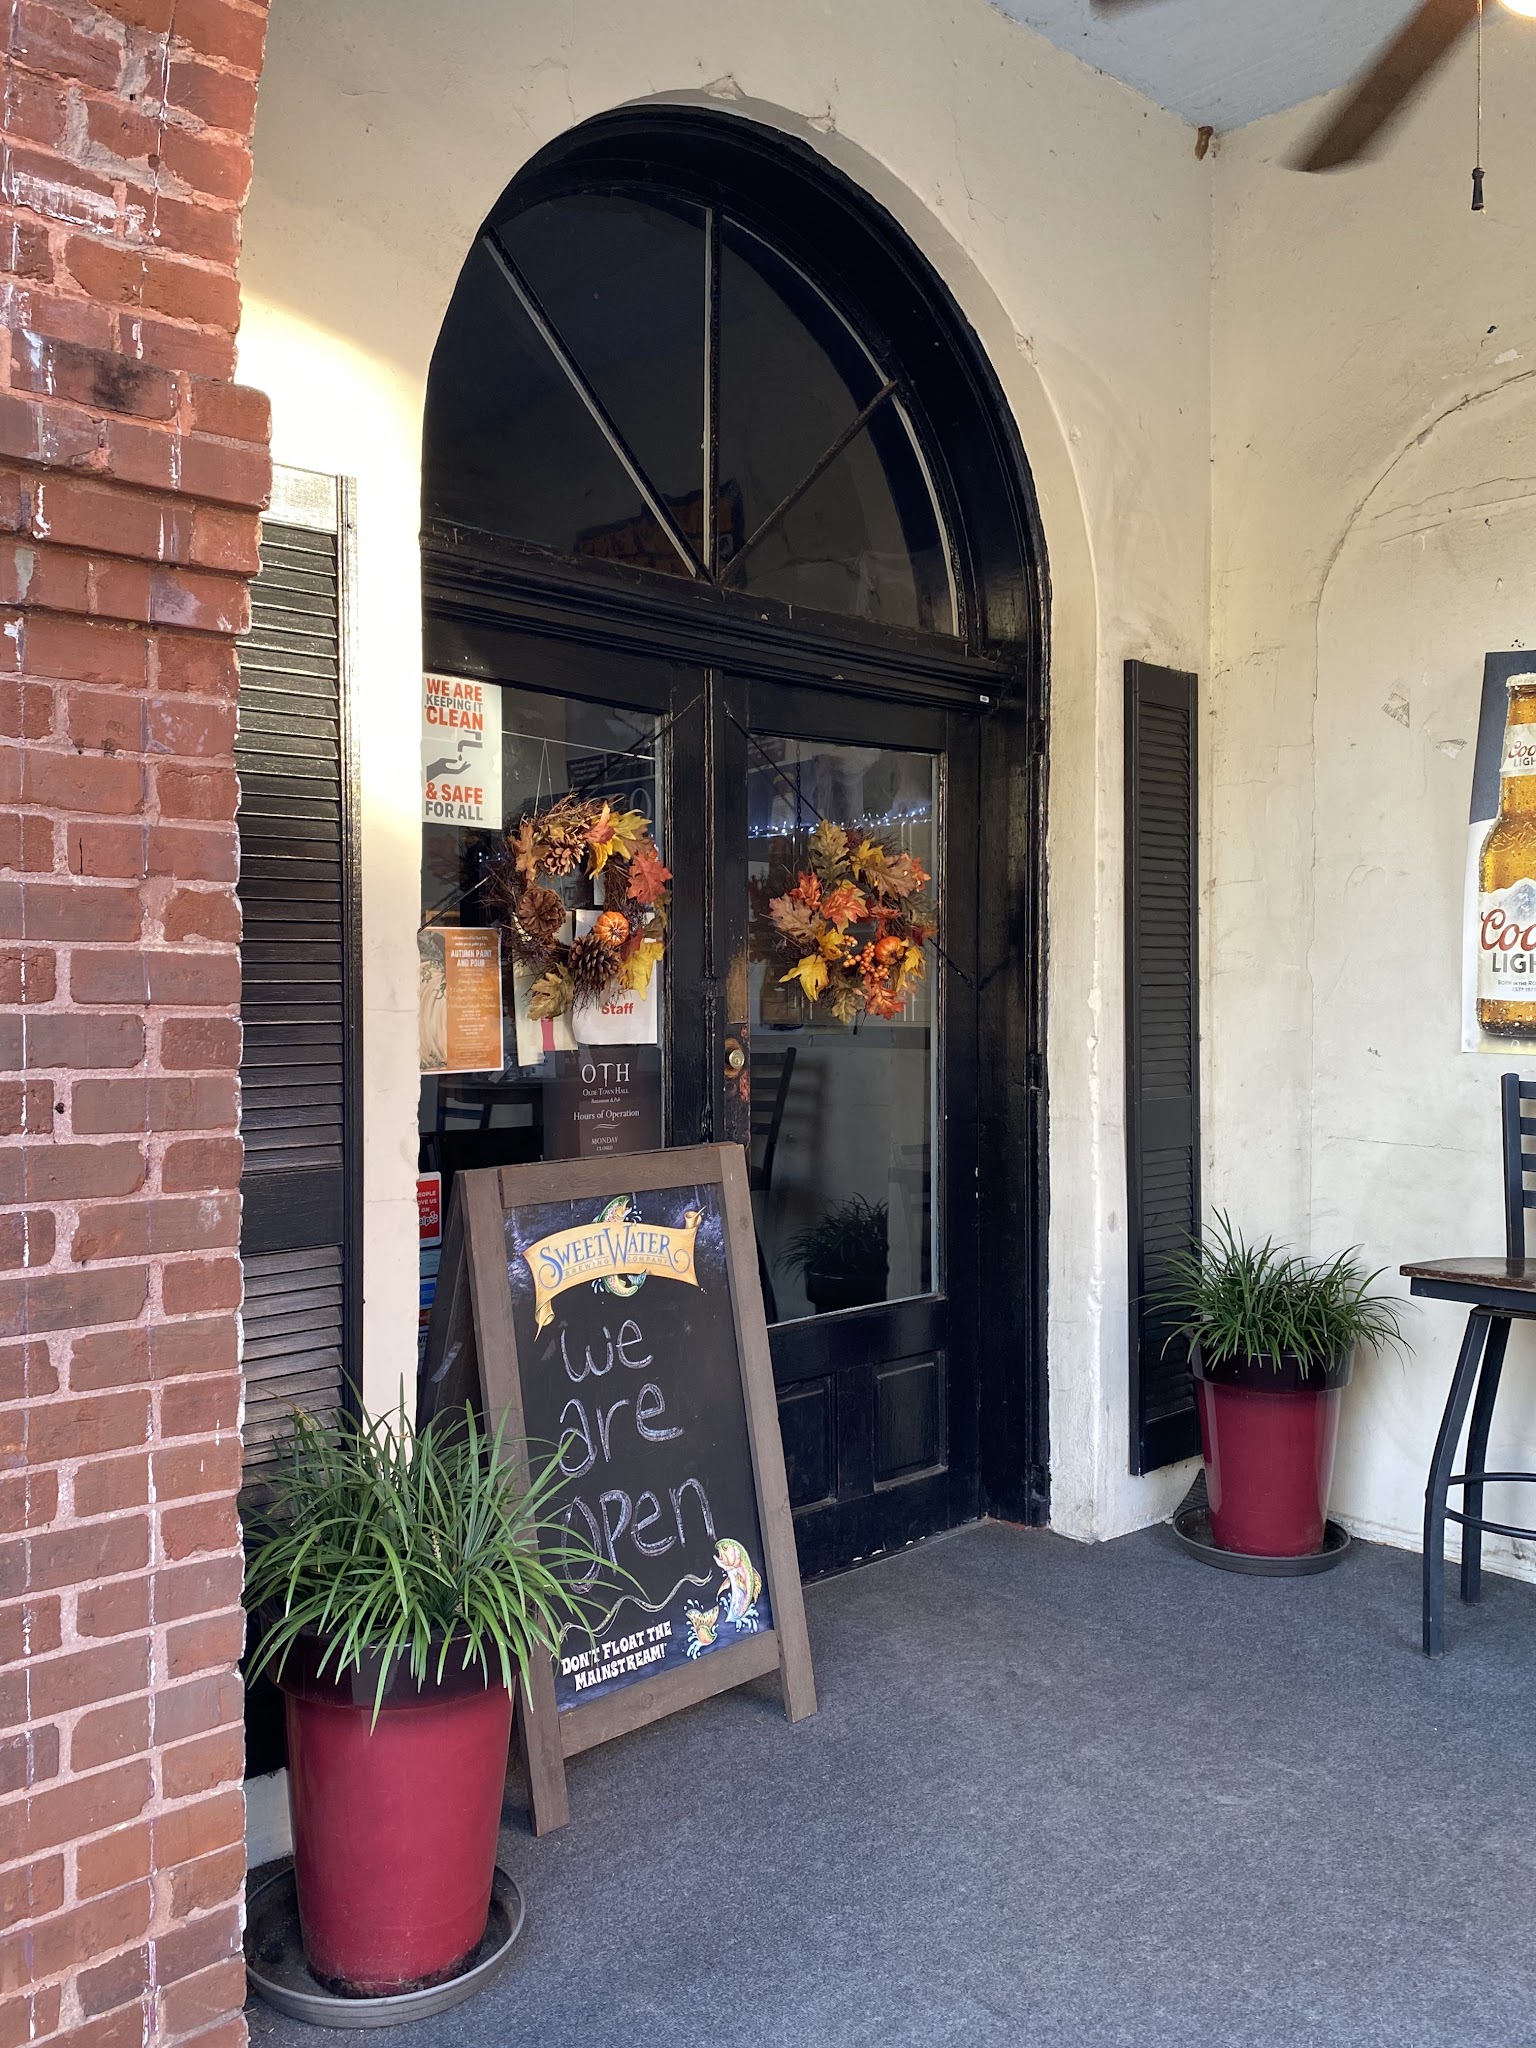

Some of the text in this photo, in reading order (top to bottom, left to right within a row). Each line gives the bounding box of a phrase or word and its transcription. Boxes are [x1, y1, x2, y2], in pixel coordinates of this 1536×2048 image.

[427, 678, 483, 702] WE ARE
[426, 694, 483, 713] KEEPING IT
[426, 706, 483, 731] CLEAN
[426, 782, 483, 805] & SAFE
[425, 801, 483, 821] FOR ALL
[450, 949, 492, 958] AUTUMN PAINT
[456, 959, 486, 967] AND POUR
[601, 1003, 634, 1015] Staff
[581, 1063, 630, 1087] OTH
[573, 1108, 640, 1121] Hours of Operation
[591, 1136, 618, 1145] MONDAY
[419, 1216, 430, 1226] elp
[565, 1255, 669, 1277] BREWING COMPANY
[558, 1383, 684, 1478] are
[561, 1620, 673, 1676] DON'T FLOAT THE
[574, 1643, 666, 1692] MAINSTREAM!
